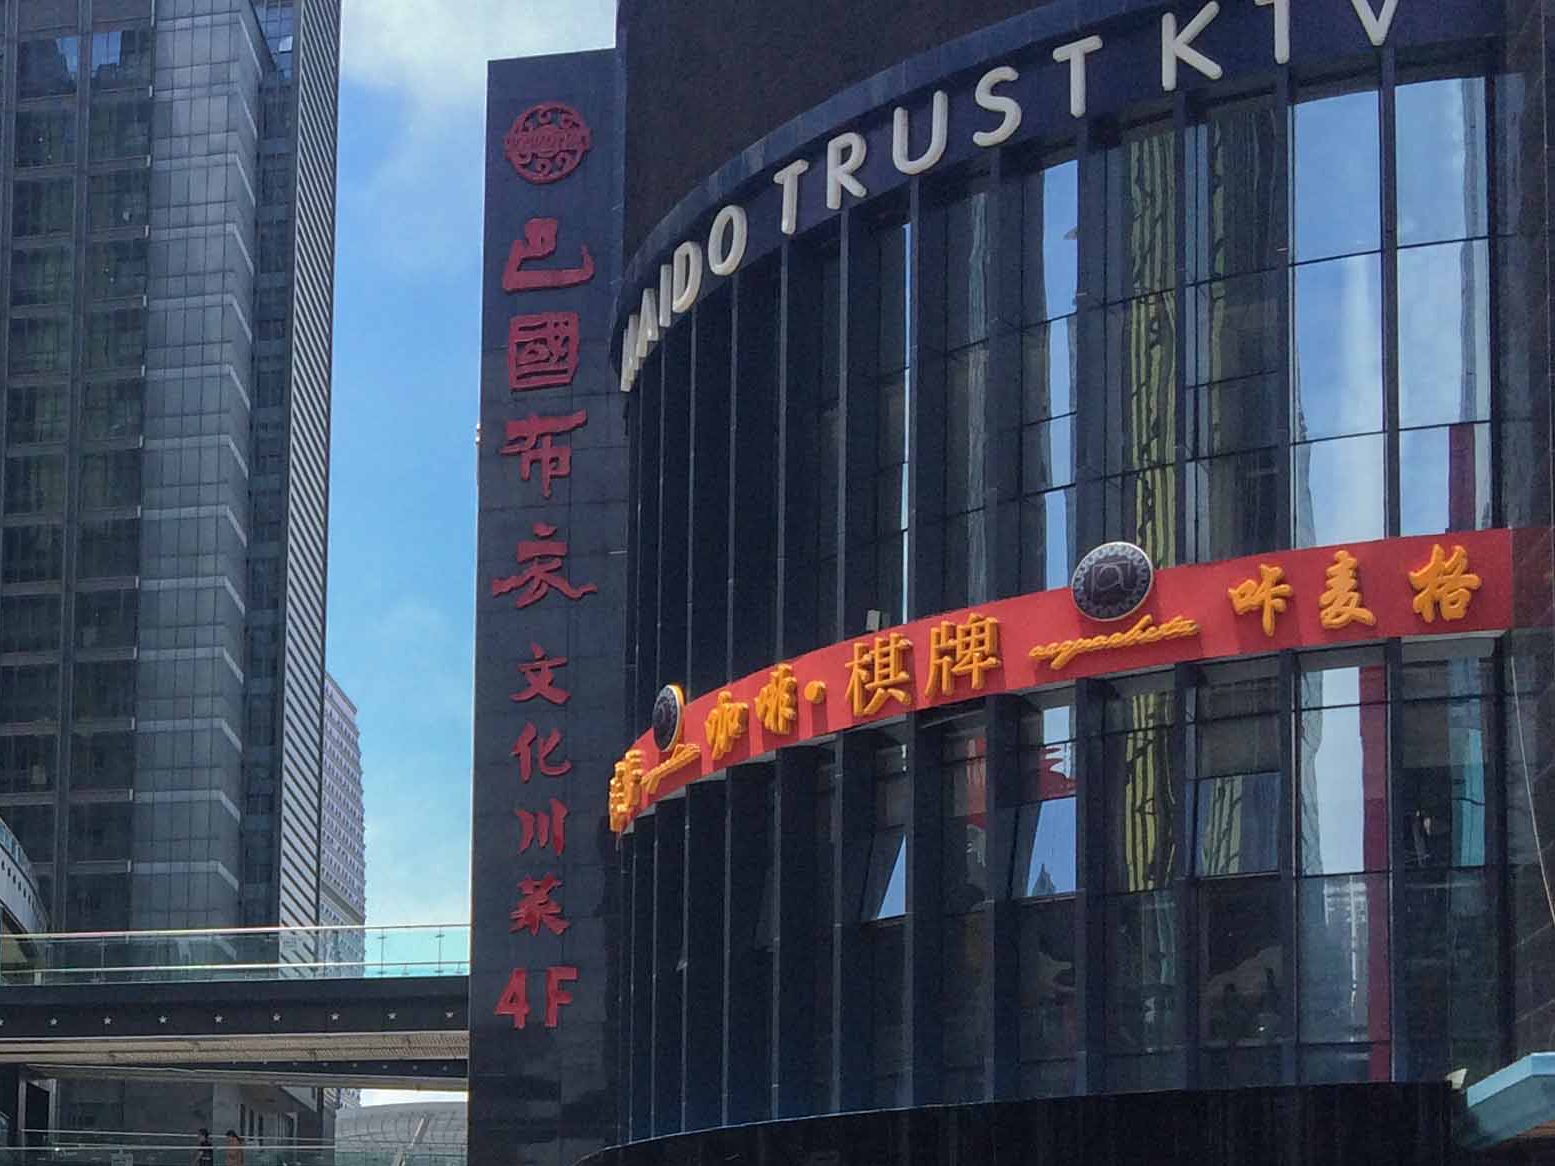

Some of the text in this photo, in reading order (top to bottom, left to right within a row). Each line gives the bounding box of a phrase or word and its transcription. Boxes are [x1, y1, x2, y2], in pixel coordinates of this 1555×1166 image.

[774, 34, 1103, 234] TRUST
[1161, 0, 1398, 91] KTV
[493, 966, 578, 1028] 4F
